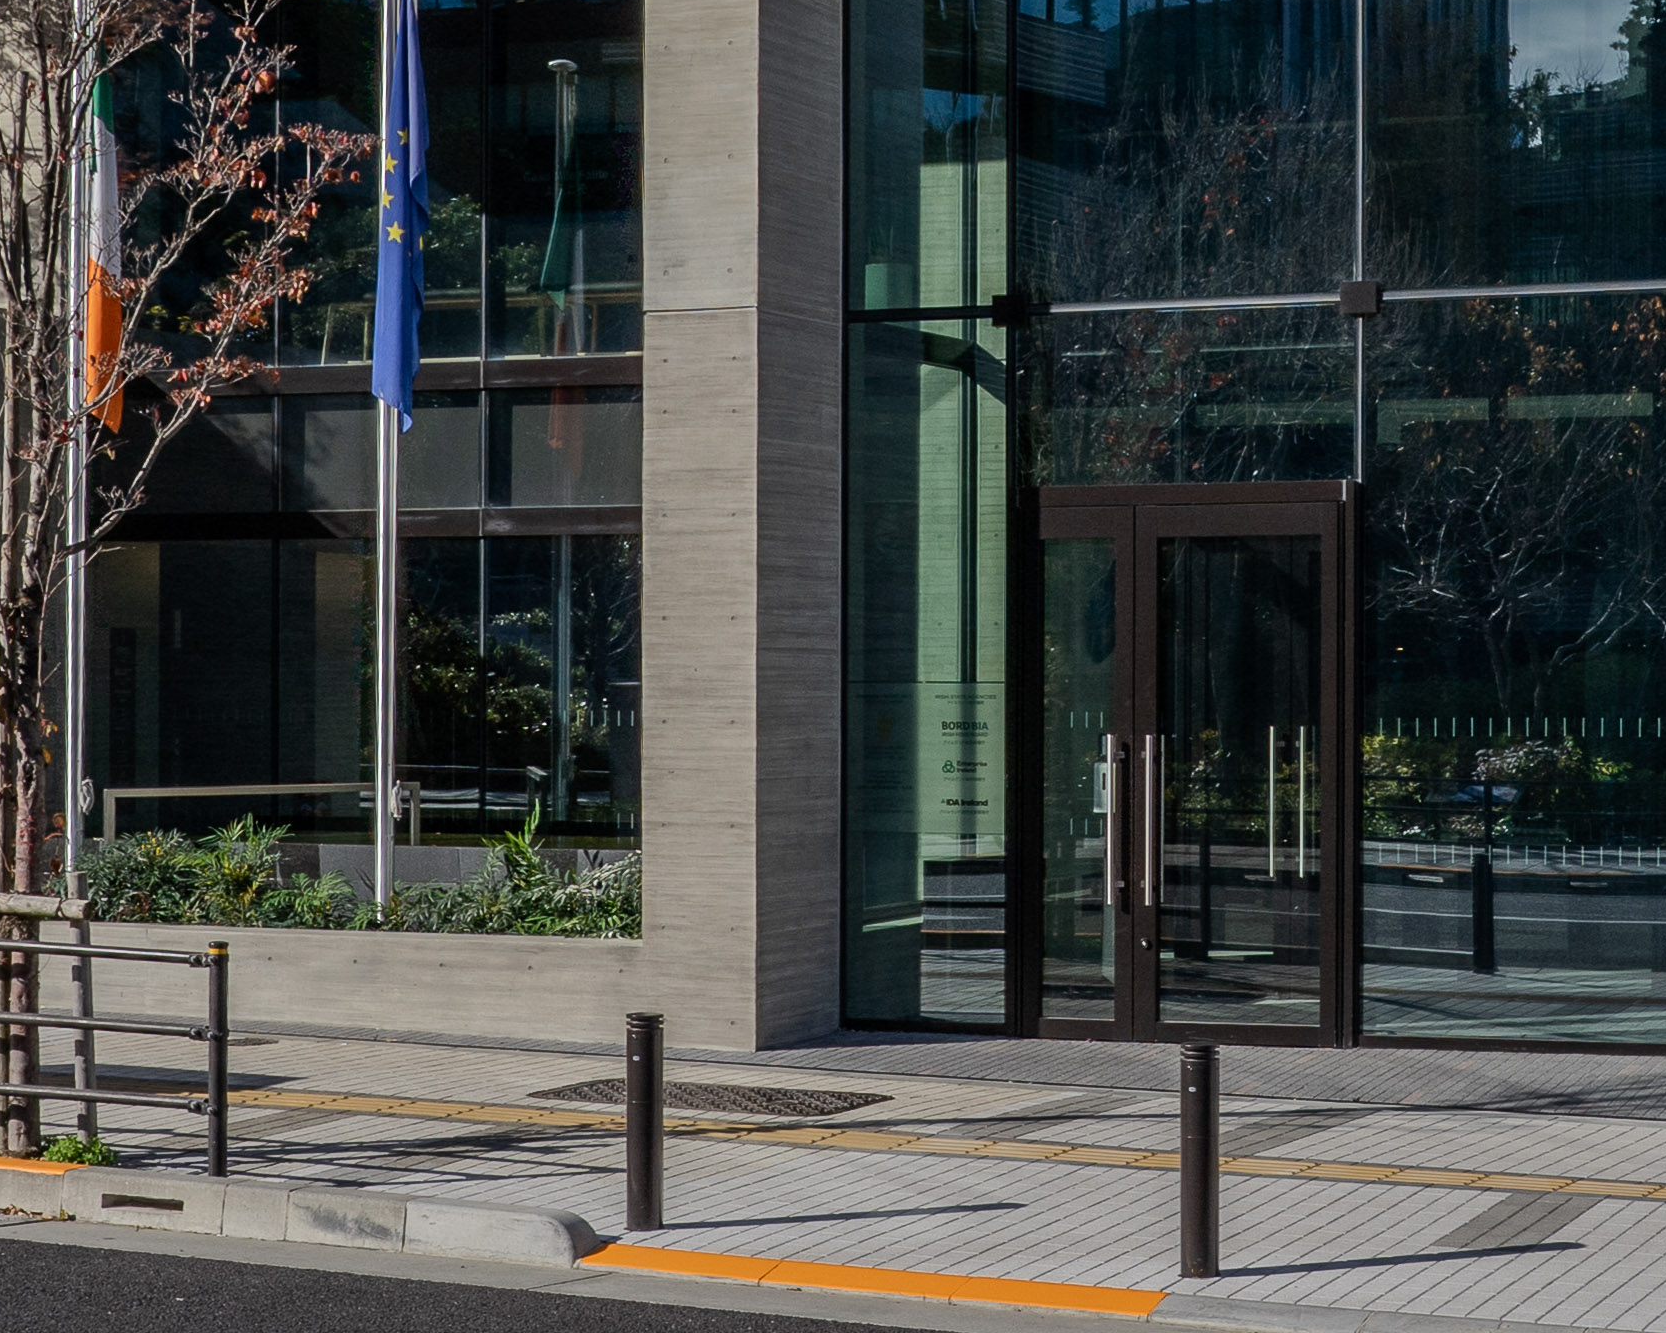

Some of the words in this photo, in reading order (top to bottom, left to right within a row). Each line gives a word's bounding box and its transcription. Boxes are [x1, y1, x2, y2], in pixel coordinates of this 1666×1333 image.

[941, 720, 970, 730] BORD
[971, 720, 989, 730] BIA
[946, 798, 960, 806] IDA
